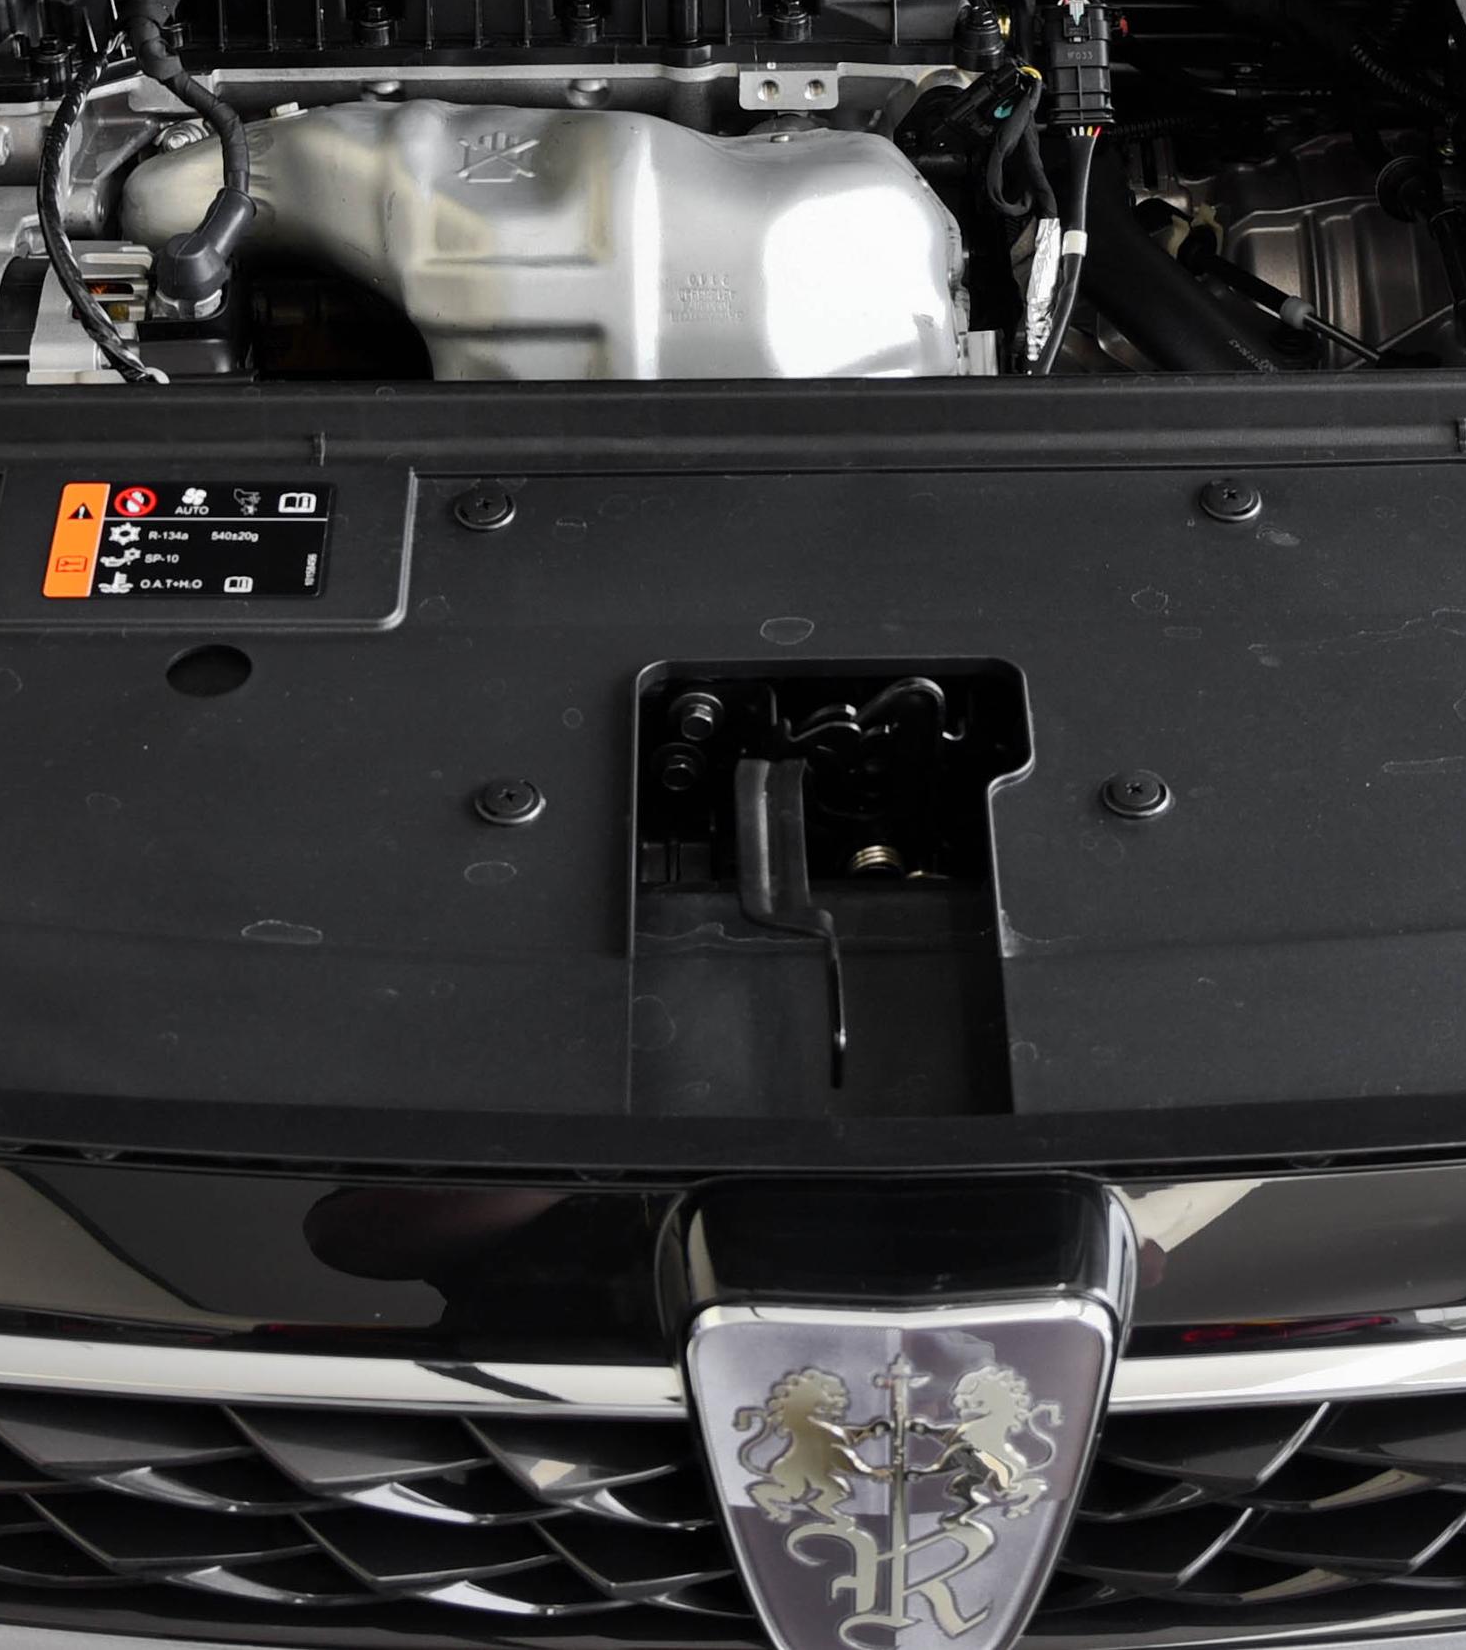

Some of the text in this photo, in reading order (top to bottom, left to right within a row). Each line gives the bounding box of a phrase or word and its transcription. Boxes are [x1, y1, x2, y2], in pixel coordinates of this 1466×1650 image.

[174, 505, 209, 515] AUTO
[148, 531, 259, 542] R-134a 540±20g
[144, 553, 180, 563] SP-10
